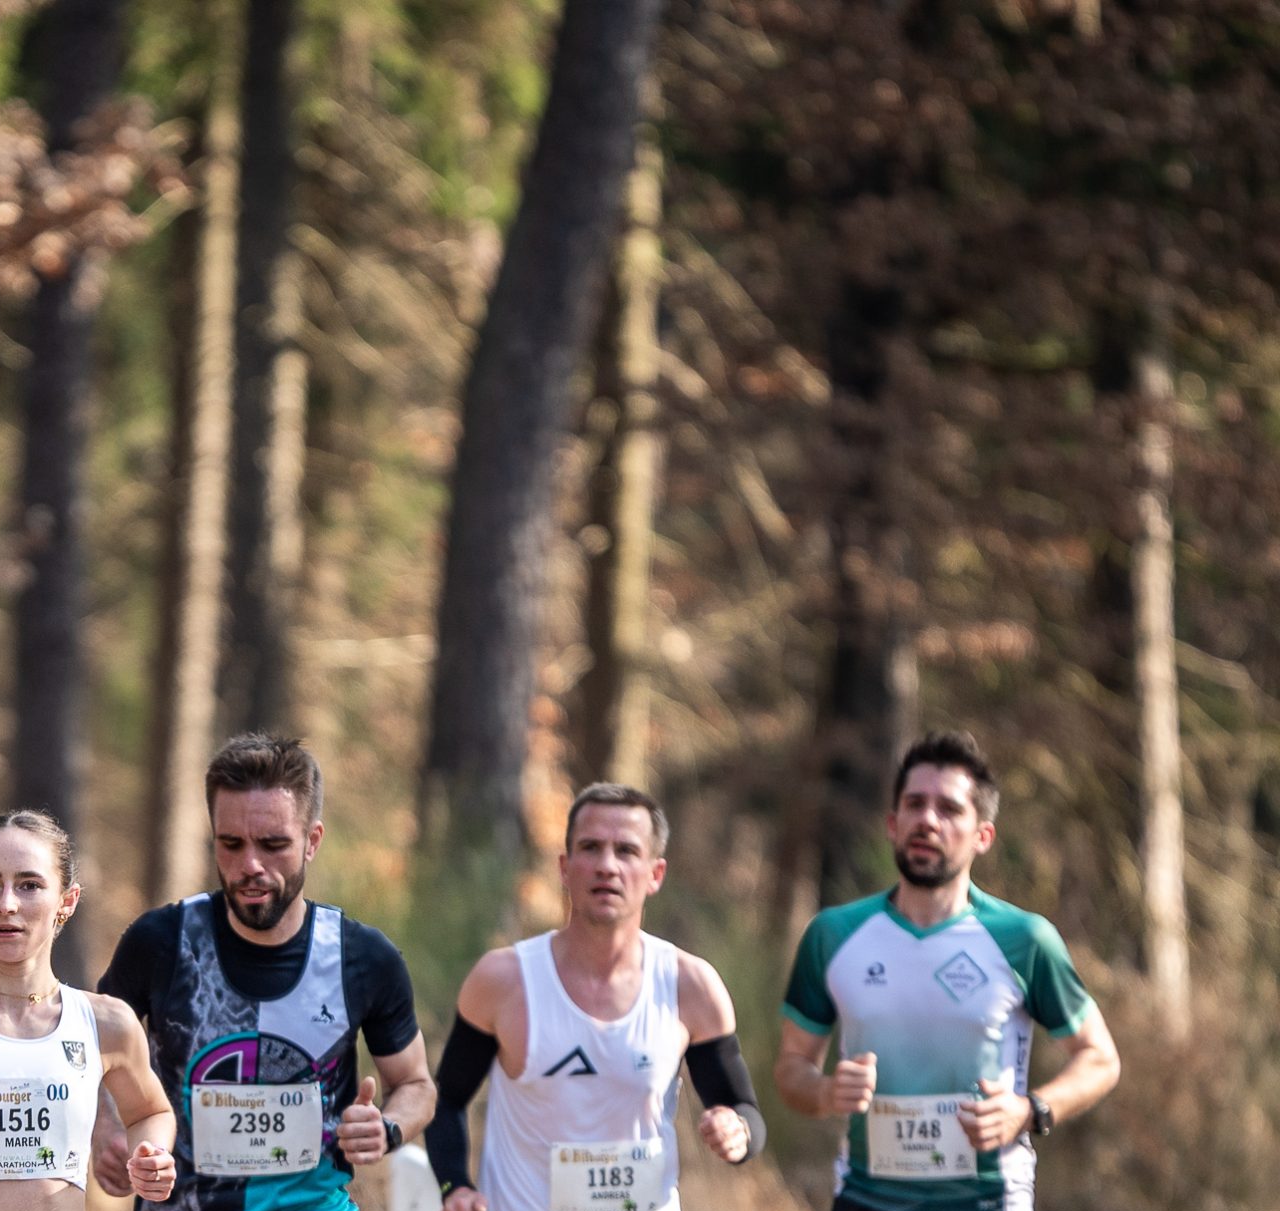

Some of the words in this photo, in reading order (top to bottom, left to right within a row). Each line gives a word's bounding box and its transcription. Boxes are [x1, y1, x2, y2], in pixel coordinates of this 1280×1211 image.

[46, 1083, 69, 1101] 0.0
[214, 1091, 267, 1109] Bitburger
[280, 1091, 303, 1107] 0.0
[230, 1112, 286, 1133] 2398
[895, 1119, 941, 1140] 1748
[5, 1137, 41, 1148] MAREN
[249, 1138, 266, 1147] JAN
[227, 1158, 272, 1166] MARATHON
[588, 1166, 634, 1187] 1183
[591, 1191, 631, 1200] ANDREAS
